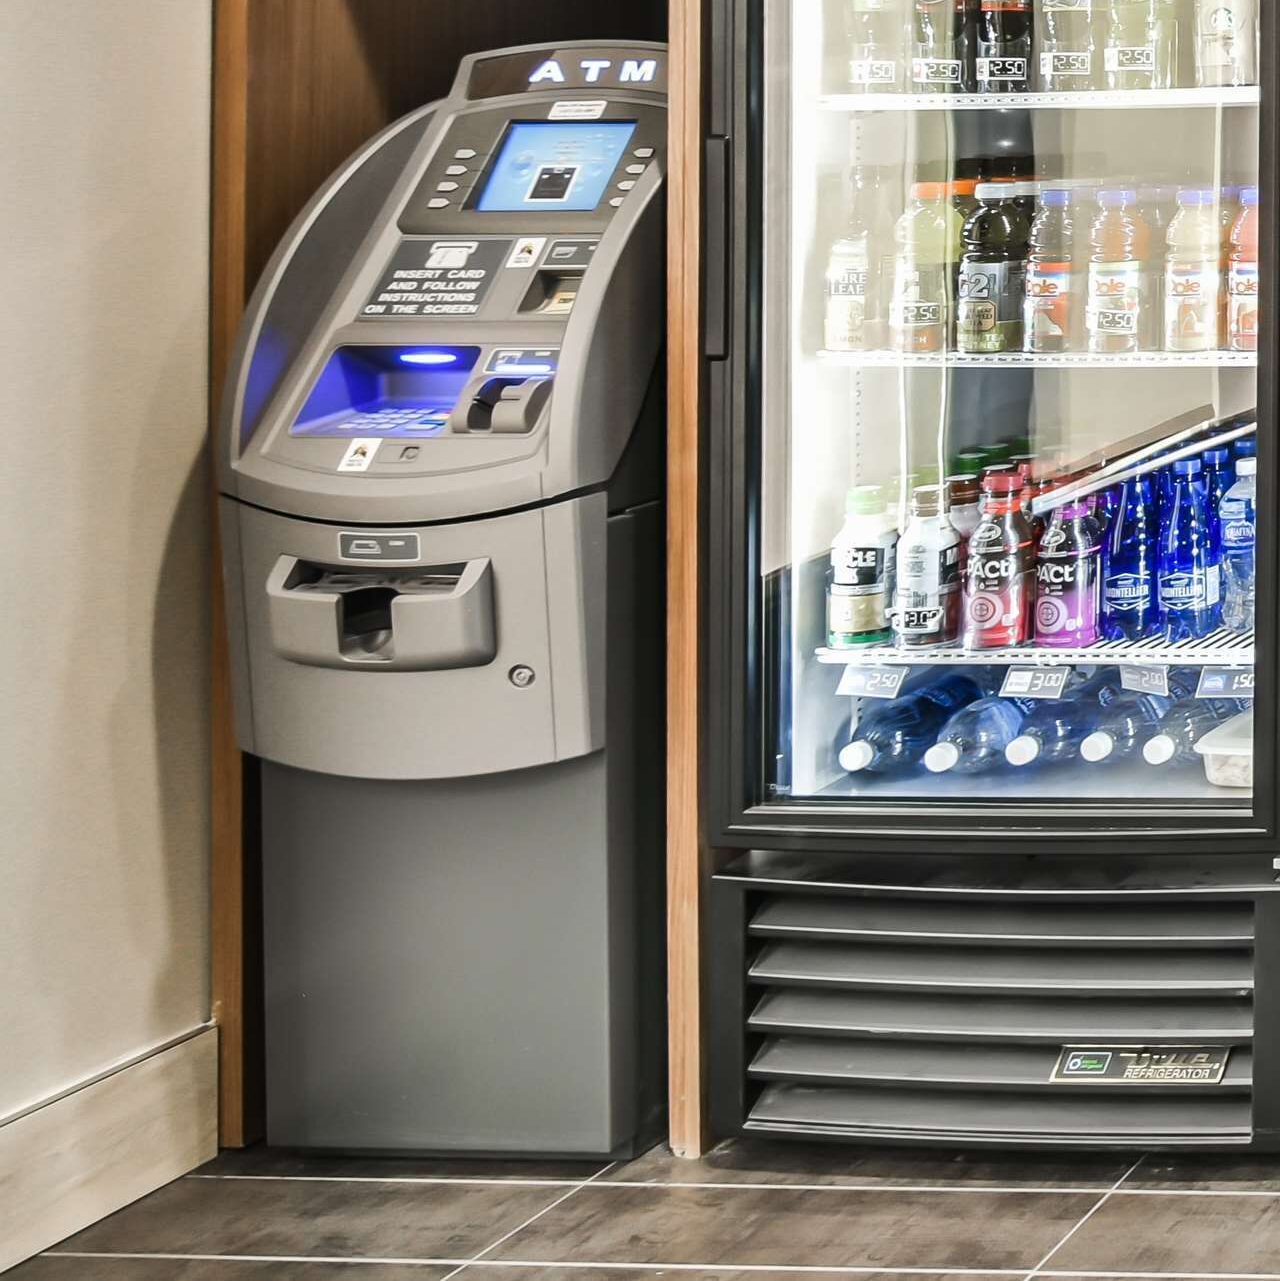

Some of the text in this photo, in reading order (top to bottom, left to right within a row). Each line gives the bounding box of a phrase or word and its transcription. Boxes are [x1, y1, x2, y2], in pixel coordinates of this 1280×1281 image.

[528, 59, 657, 83] ATM
[990, 61, 1024, 75] $2.50
[393, 269, 486, 279] INSERT CARD
[387, 281, 481, 290] AND FOLLOW
[377, 293, 476, 302] INSTRUCTIONS
[364, 304, 479, 314] ON THE SCREEN
[867, 673, 898, 691] 2.50
[1032, 673, 1062, 691] 3.00
[1141, 672, 1163, 687] 2.00
[1123, 1068, 1210, 1079] REFRIGERATOR
